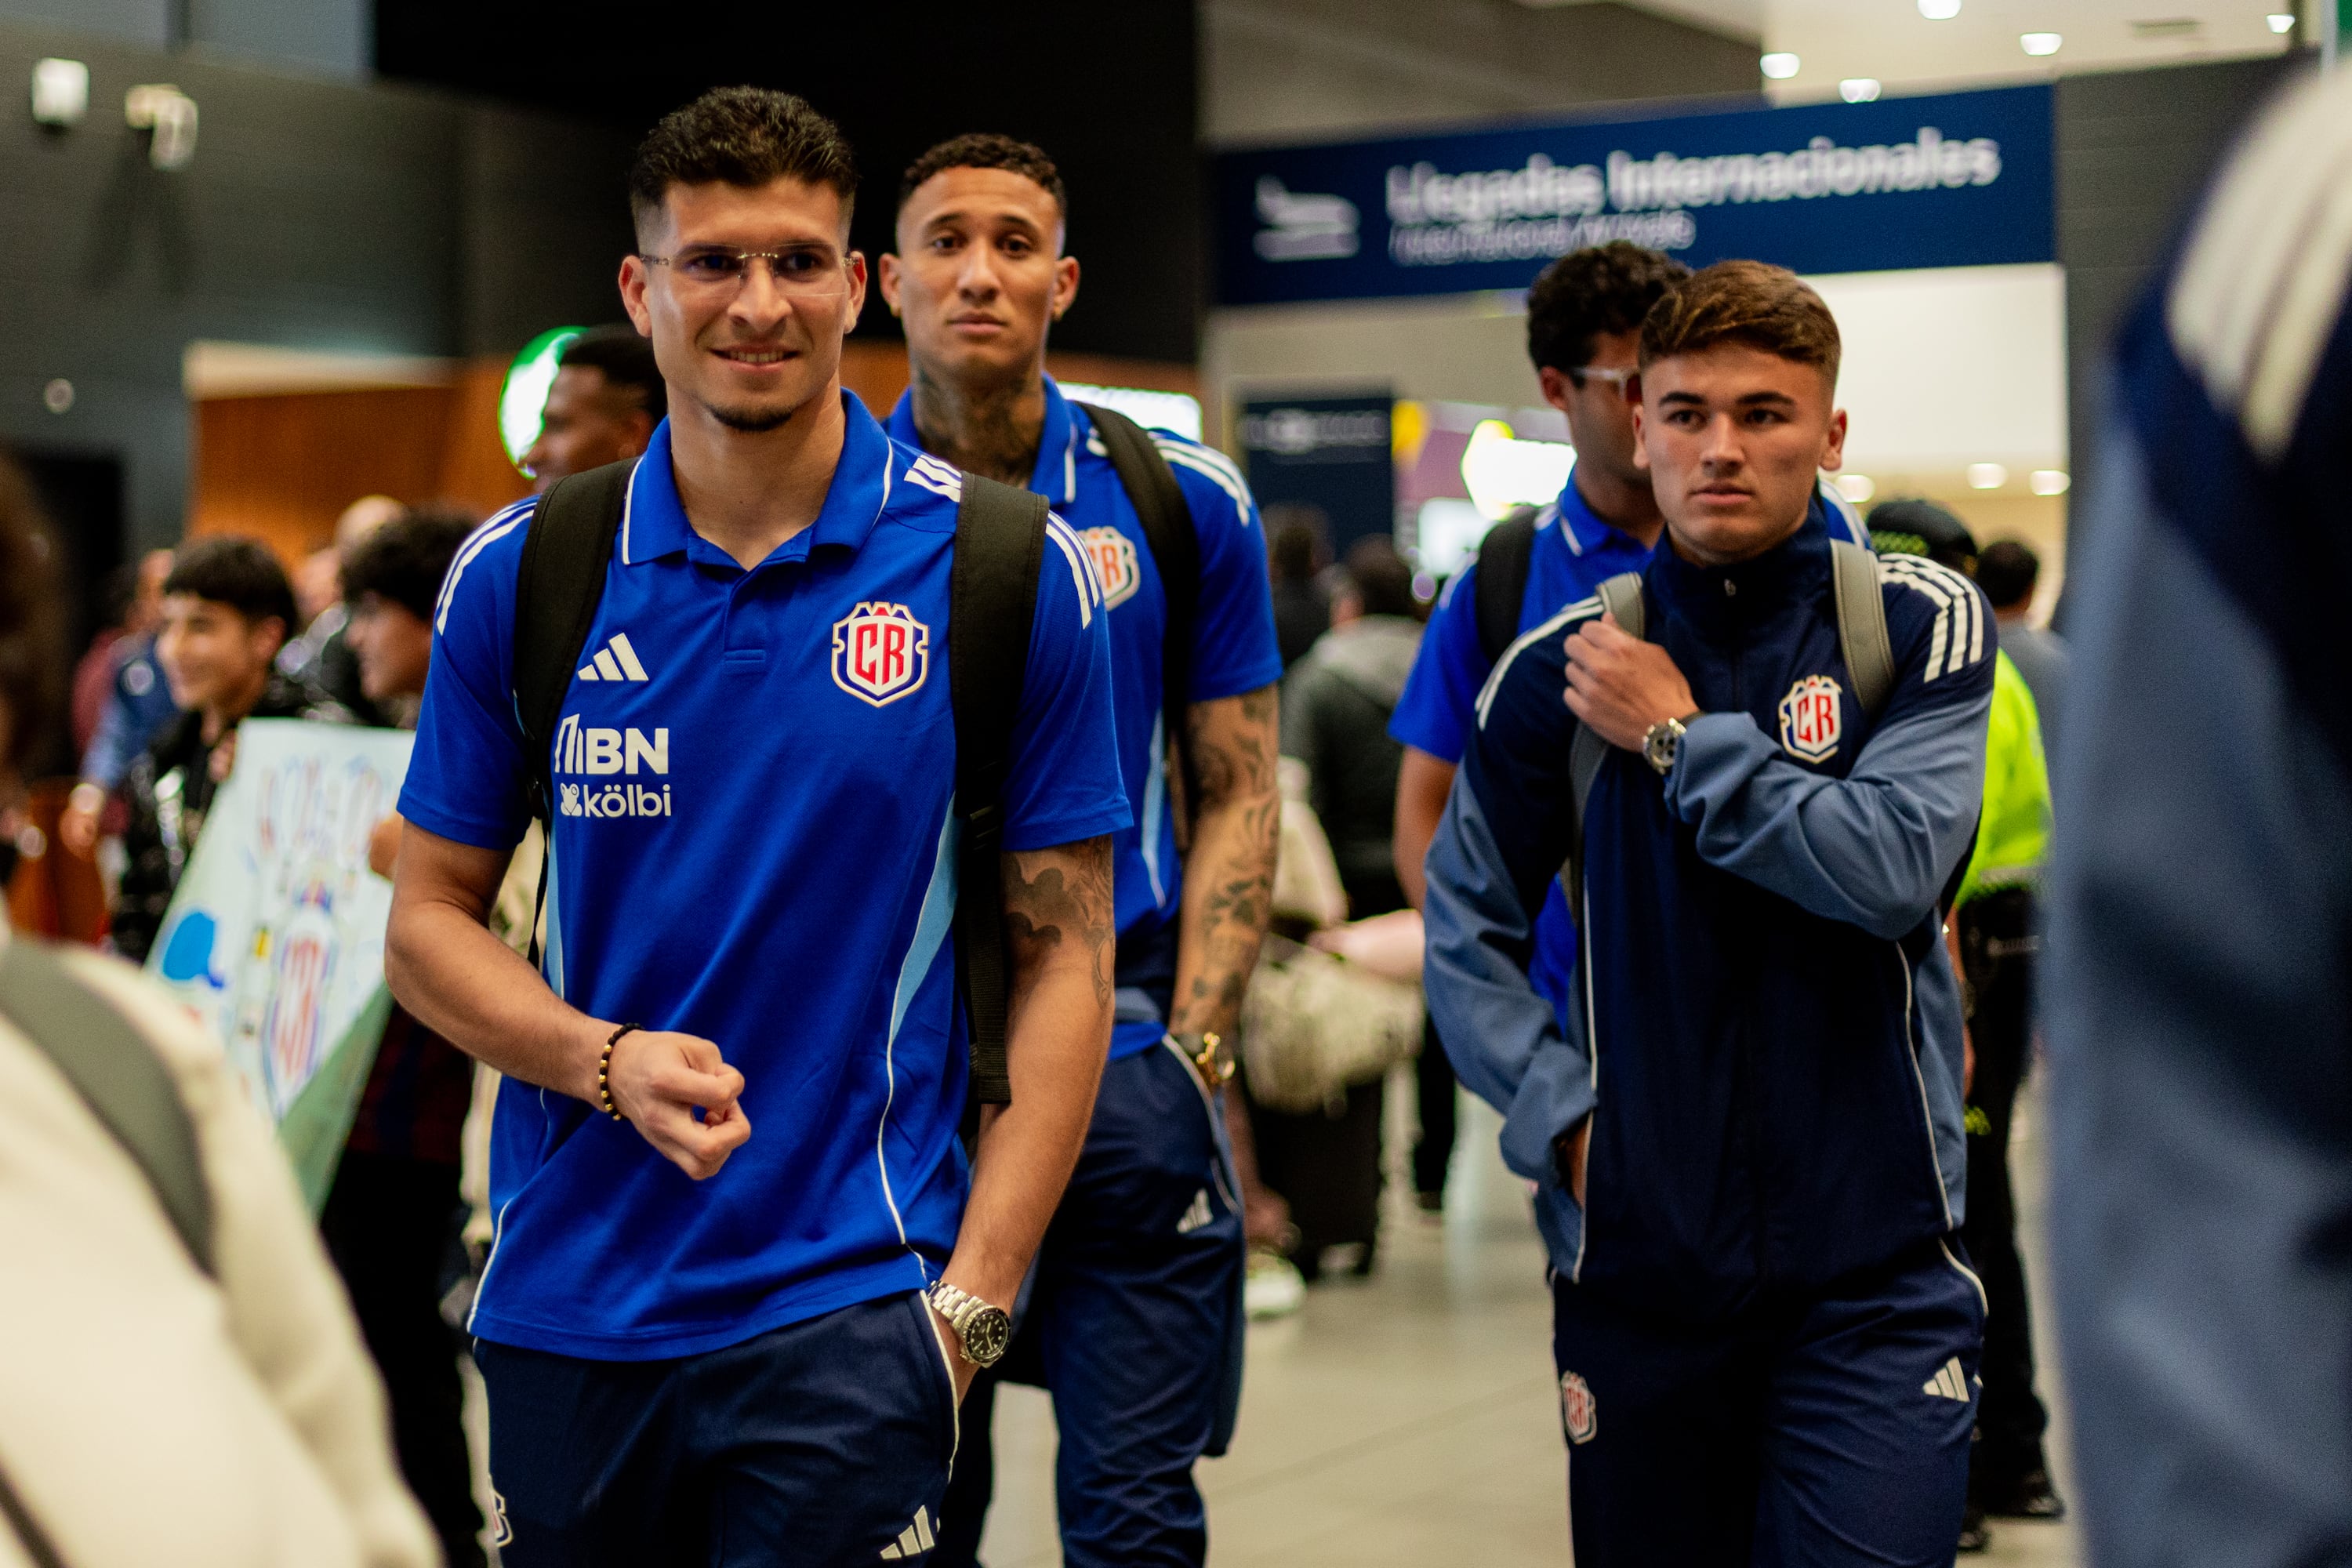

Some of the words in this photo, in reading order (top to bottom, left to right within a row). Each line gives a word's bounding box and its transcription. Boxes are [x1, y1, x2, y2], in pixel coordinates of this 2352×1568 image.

[1386, 153, 1605, 223] Llegadas
[1606, 125, 2002, 212] Internacionales
[855, 622, 906, 686] CR
[1798, 695, 1834, 744] CR
[583, 784, 671, 817] kölbi
